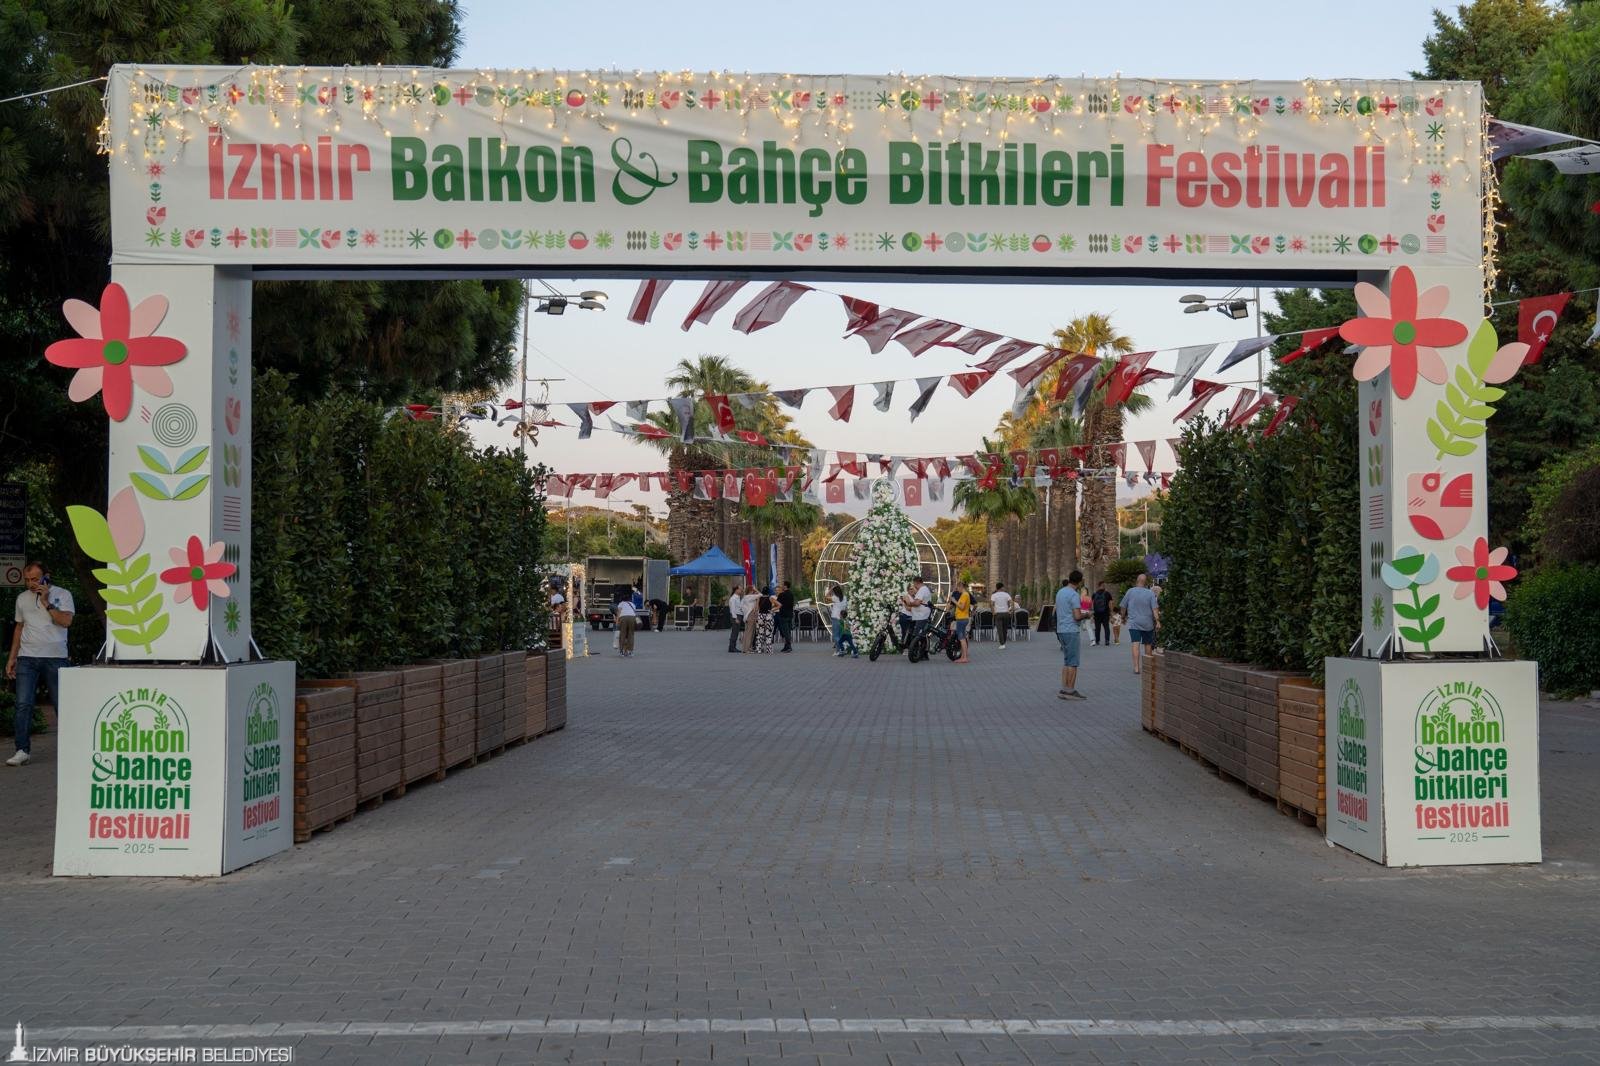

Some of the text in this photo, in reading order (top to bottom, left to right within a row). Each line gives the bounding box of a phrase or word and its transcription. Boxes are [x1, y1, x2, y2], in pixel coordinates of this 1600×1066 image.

[207, 126, 1386, 218] İzmir Balkon & Bahçe Bitkileri Festivali
[118, 687, 168, 707] İZMİR
[1436, 681, 1482, 699] İZMİR
[100, 720, 185, 753] balkon
[247, 716, 279, 746] balkon
[1421, 714, 1500, 745] balkon
[90, 783, 191, 810] bitkileri
[243, 768, 280, 802] bitkileri
[1415, 774, 1508, 801] bitkileri
[89, 812, 190, 839] festivali
[243, 795, 280, 831] festivali
[1415, 802, 1510, 829] festivali
[124, 843, 155, 854] 2025
[1450, 832, 1479, 843] 2025
